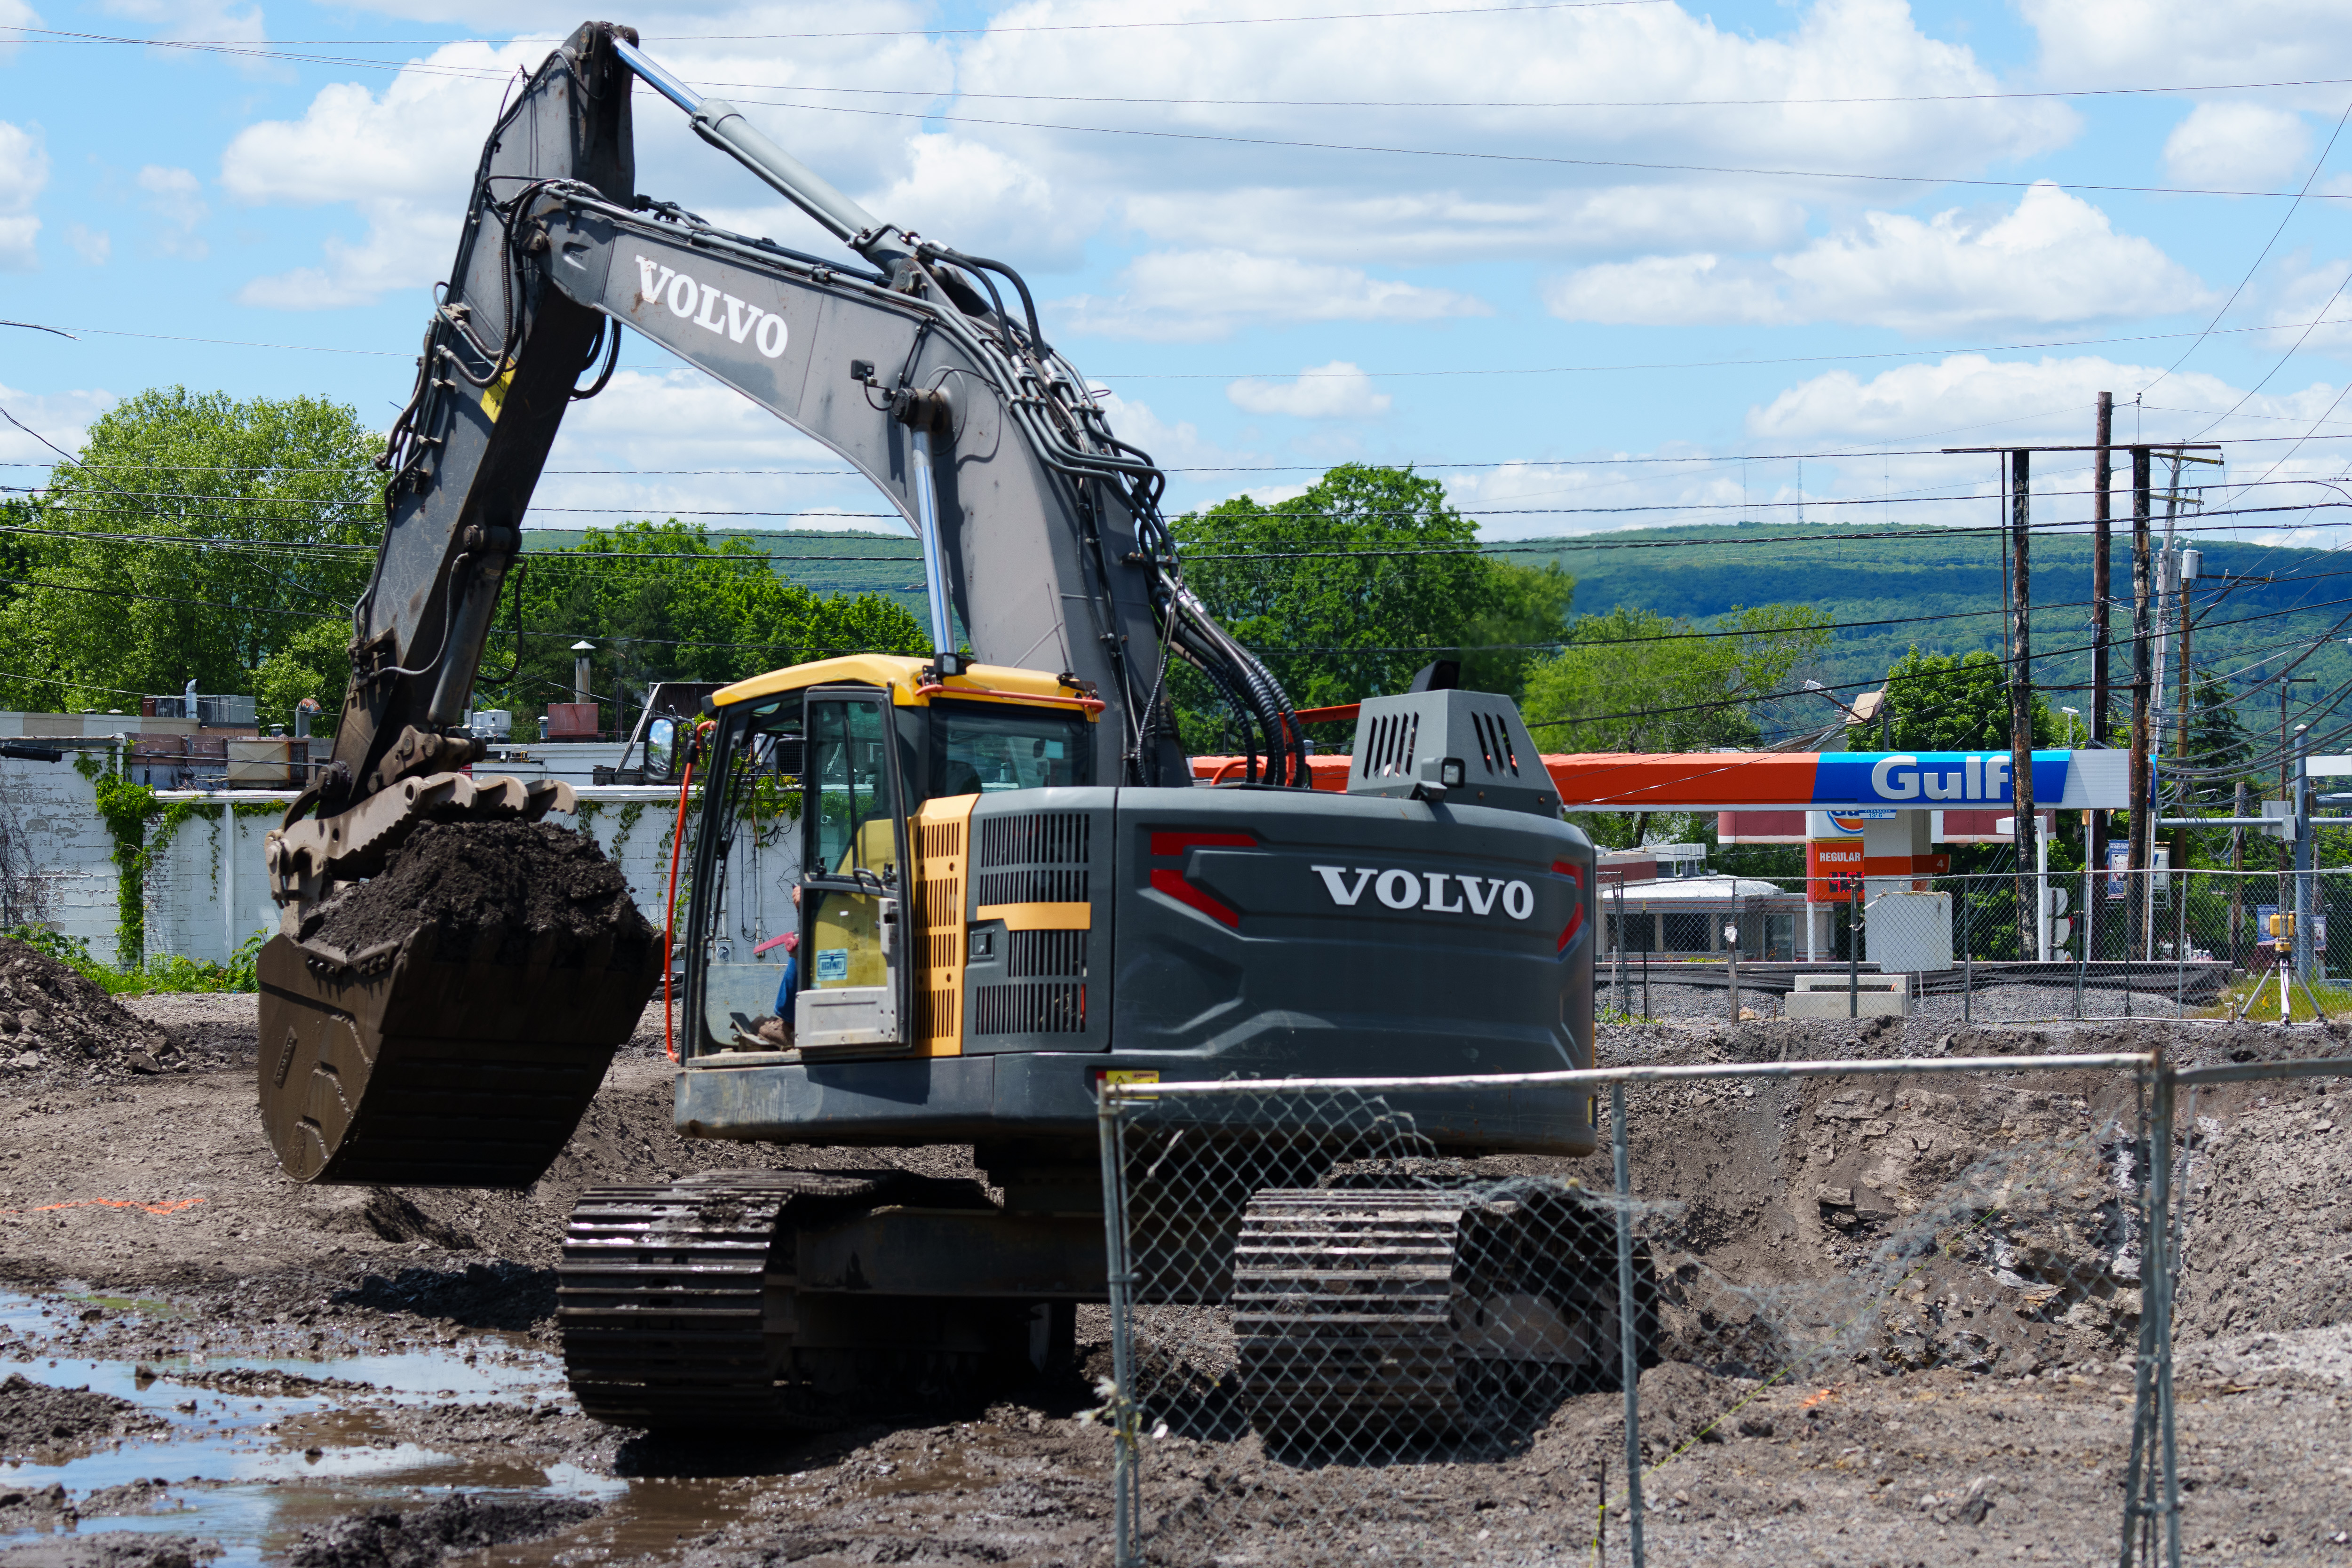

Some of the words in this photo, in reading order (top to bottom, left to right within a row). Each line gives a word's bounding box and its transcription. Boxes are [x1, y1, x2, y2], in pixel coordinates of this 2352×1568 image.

[635, 255, 788, 358] VOLVO
[1872, 755, 2010, 800] Gulf
[1820, 852, 1860, 862] REGULAR
[1311, 865, 1534, 920] VOLVO
